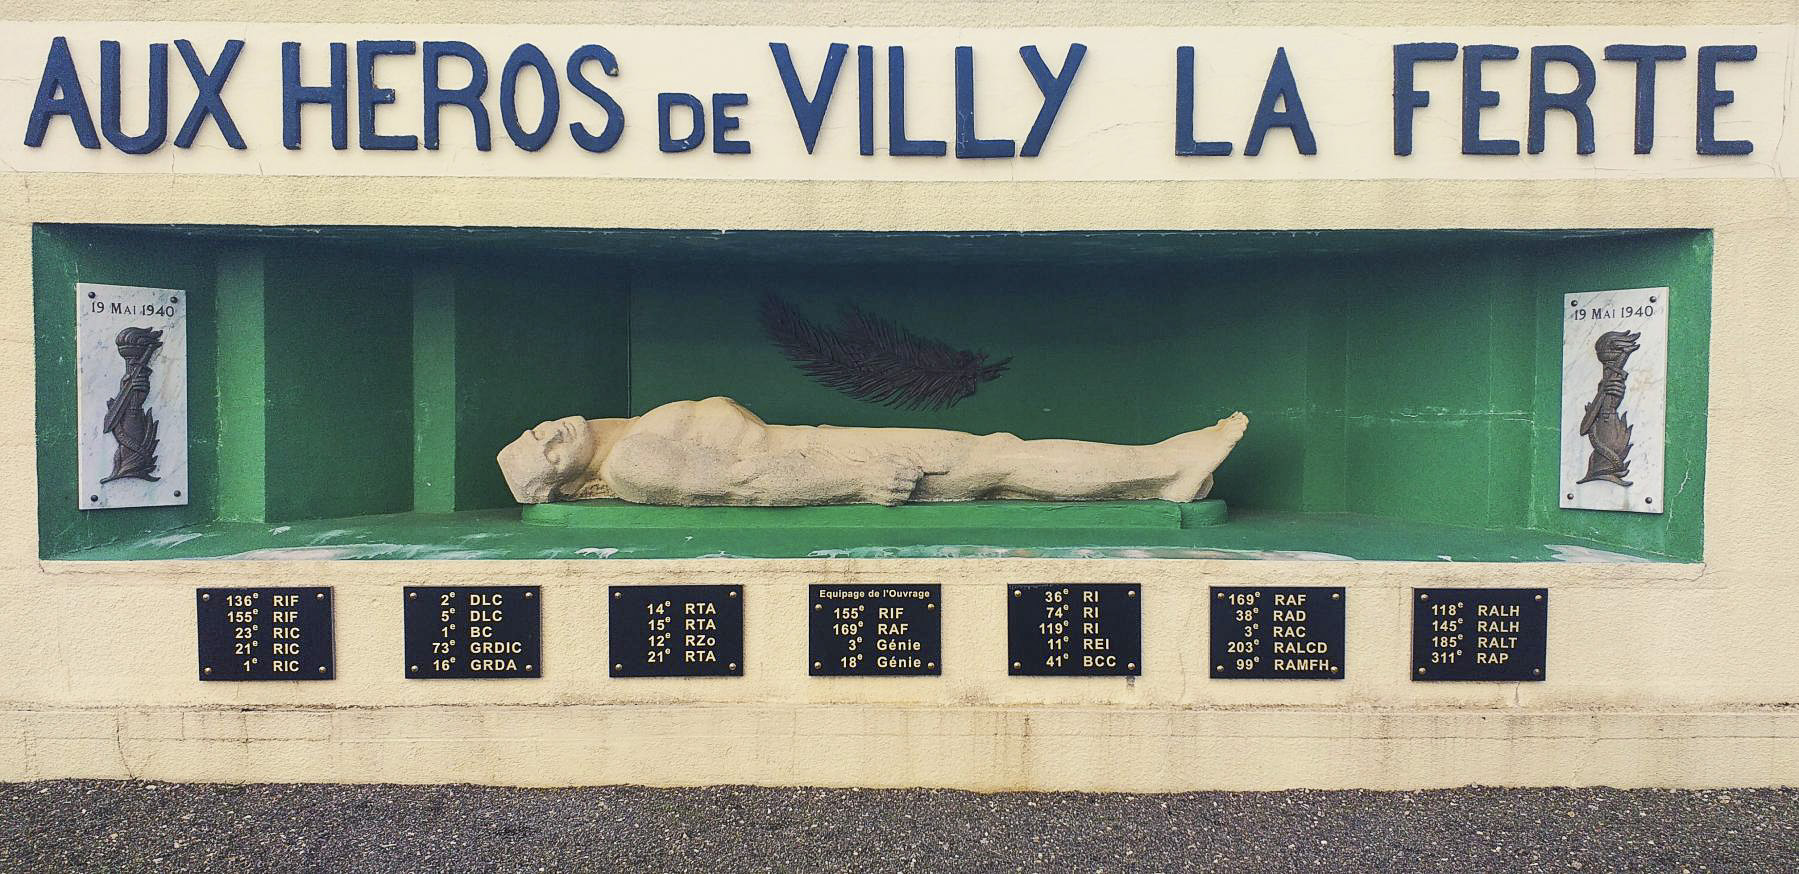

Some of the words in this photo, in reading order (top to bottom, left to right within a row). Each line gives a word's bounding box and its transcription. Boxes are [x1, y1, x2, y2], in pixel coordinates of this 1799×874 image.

[24, 37, 247, 154] AUX
[281, 41, 625, 153] HEROS
[657, 92, 752, 153] DE
[769, 43, 1088, 158] VILLY
[1175, 46, 1317, 157] LA
[1394, 43, 1758, 156] FERTE
[91, 301, 105, 314] 19
[141, 305, 175, 317] 1940
[1574, 309, 1587, 321] 19
[1621, 306, 1654, 318] 1940
[227, 593, 258, 606] 136e
[274, 595, 299, 606] RIF
[441, 592, 455, 605] 2e
[470, 594, 502, 605] DLC
[819, 590, 864, 599] Equipage
[868, 590, 880, 598] de
[883, 590, 930, 599] l'Ouvrage
[1045, 589, 1068, 602] 36e
[1084, 591, 1098, 602] RI
[1229, 592, 1260, 605] 169e
[1275, 594, 1306, 605] RAF
[648, 601, 670, 614] 14e
[686, 603, 716, 614] RTA
[834, 605, 864, 619] 155e
[879, 608, 903, 619] RIF
[1046, 604, 1068, 618] 74e
[1084, 607, 1098, 618] RI
[1432, 602, 1463, 615] 118e
[1478, 605, 1519, 616] RALH
[228, 609, 258, 622] 155e
[274, 612, 298, 622] RIF
[442, 608, 455, 621] 5e
[471, 610, 502, 621] DLC
[1236, 608, 1258, 621] 38e
[1274, 610, 1306, 621] RAD
[648, 617, 670, 630] 15e
[686, 619, 716, 630] RTA
[833, 621, 863, 635] 169e
[878, 624, 908, 635] RAF
[1040, 620, 1068, 634] 119e
[1084, 623, 1098, 634] RI
[1245, 623, 1258, 637] 3e
[1274, 626, 1305, 637] RAC
[1433, 618, 1463, 631] 145e
[1478, 621, 1519, 632] RALH
[235, 625, 258, 638] 23e
[274, 628, 300, 638] RIC
[442, 624, 455, 637] 1e
[471, 626, 492, 637] BC
[648, 633, 670, 646] 12e
[686, 635, 715, 646] RZo
[849, 637, 862, 650] 3e
[877, 639, 920, 650] Génie
[1048, 636, 1069, 650] 11e
[1084, 639, 1109, 649] REI
[1228, 639, 1259, 653] 203e
[1274, 642, 1327, 653] RALCD
[1432, 634, 1463, 647] 185e
[1478, 637, 1517, 648] RALT
[236, 641, 258, 654] 21e
[274, 643, 299, 654] RIC
[433, 640, 455, 653] 73e
[471, 642, 521, 653] GRDIC
[648, 648, 670, 662] 21e
[686, 651, 716, 662] RTA
[841, 654, 862, 668] 18e
[878, 656, 921, 668] Génie
[1046, 653, 1068, 667] 41e
[1084, 656, 1116, 667] BCC
[1432, 650, 1462, 663] 311e
[1477, 653, 1508, 664] RAP
[244, 658, 257, 671] 1e
[273, 661, 299, 671] RIC
[434, 657, 455, 670] 16e
[471, 659, 517, 670] GRDA
[1237, 656, 1259, 670] 99e
[1275, 659, 1329, 670] RAMFH
